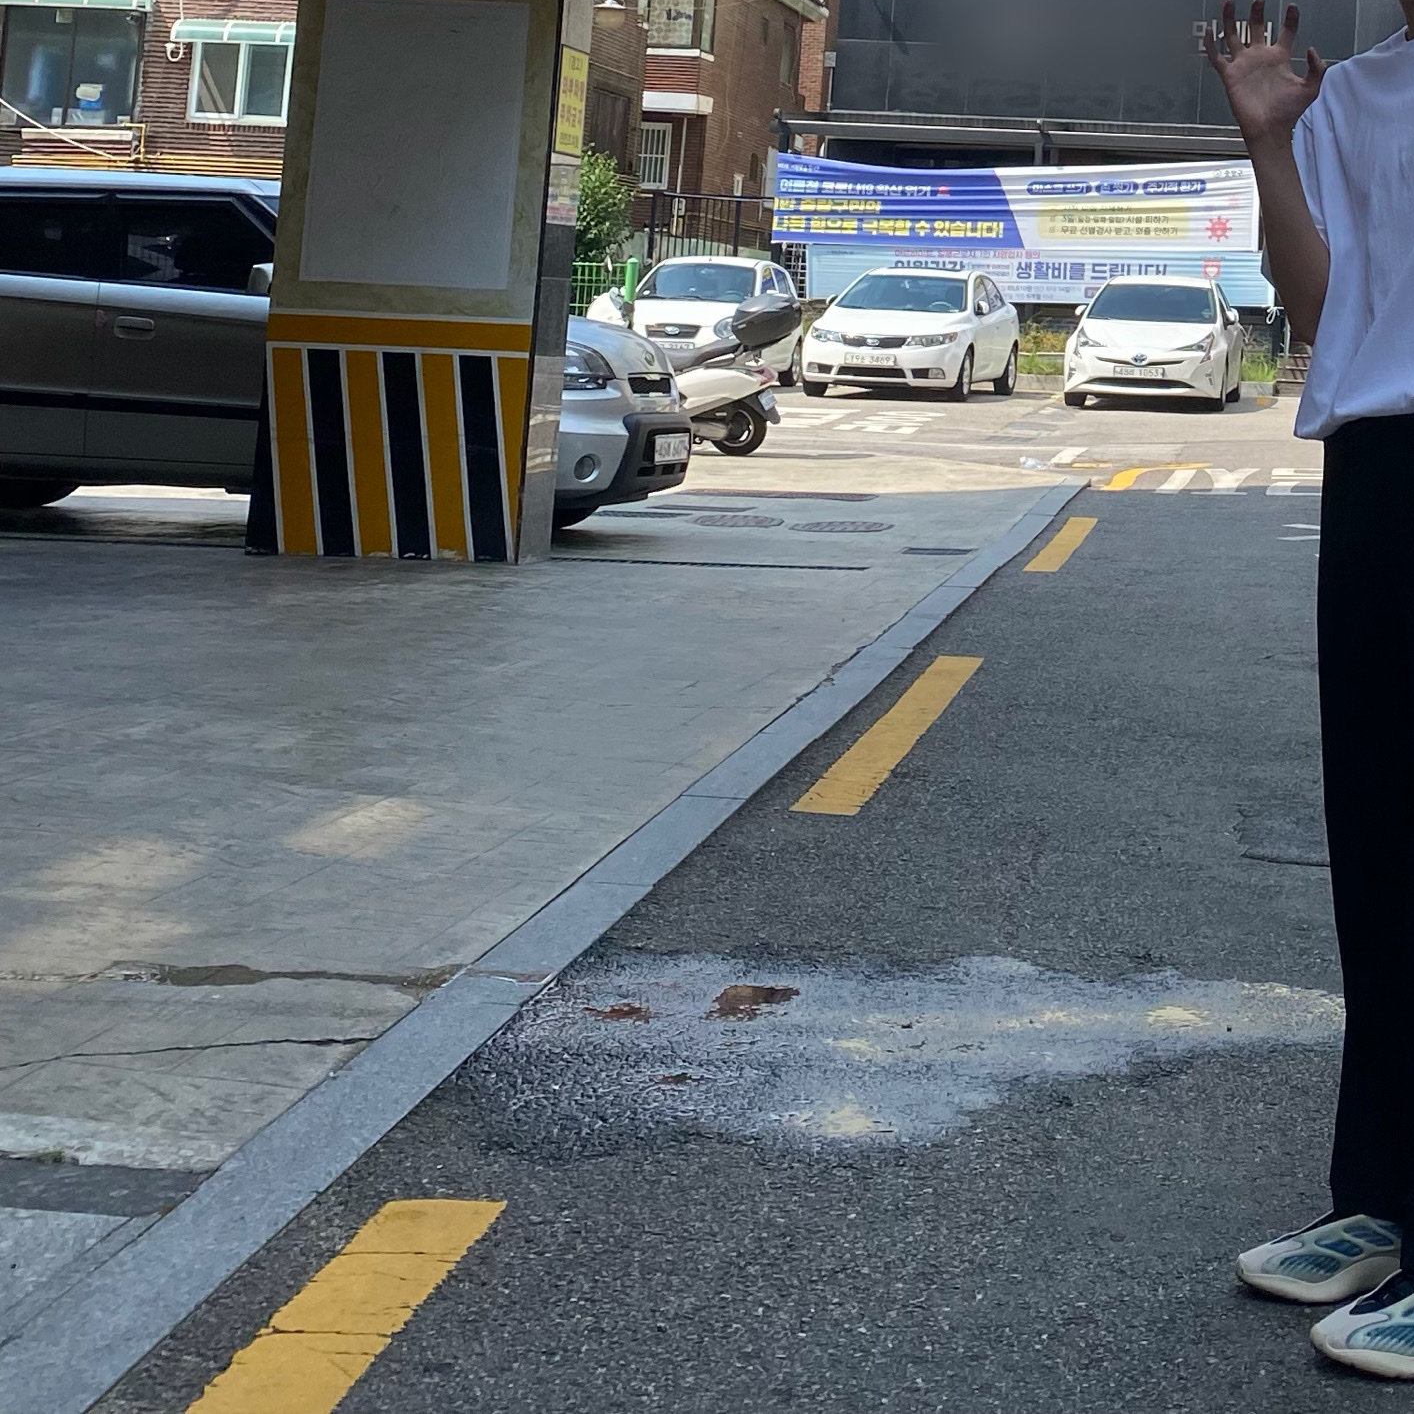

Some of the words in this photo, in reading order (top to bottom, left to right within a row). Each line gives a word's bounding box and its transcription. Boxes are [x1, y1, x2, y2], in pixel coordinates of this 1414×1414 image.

[821, 181, 874, 195] 코로나19
[904, 185, 931, 197] 위기
[1065, 183, 1086, 193] 쓰기
[1145, 215, 1169, 224] 피하기
[915, 220, 930, 237] 수
[933, 220, 1004, 238] 있습니다!
[1061, 226, 1077, 234] 무료
[1080, 226, 1112, 235] 선별검사
[1136, 226, 1151, 235] 외출
[1154, 226, 1178, 235] 안하기
[1016, 261, 1085, 281] 생활비를
